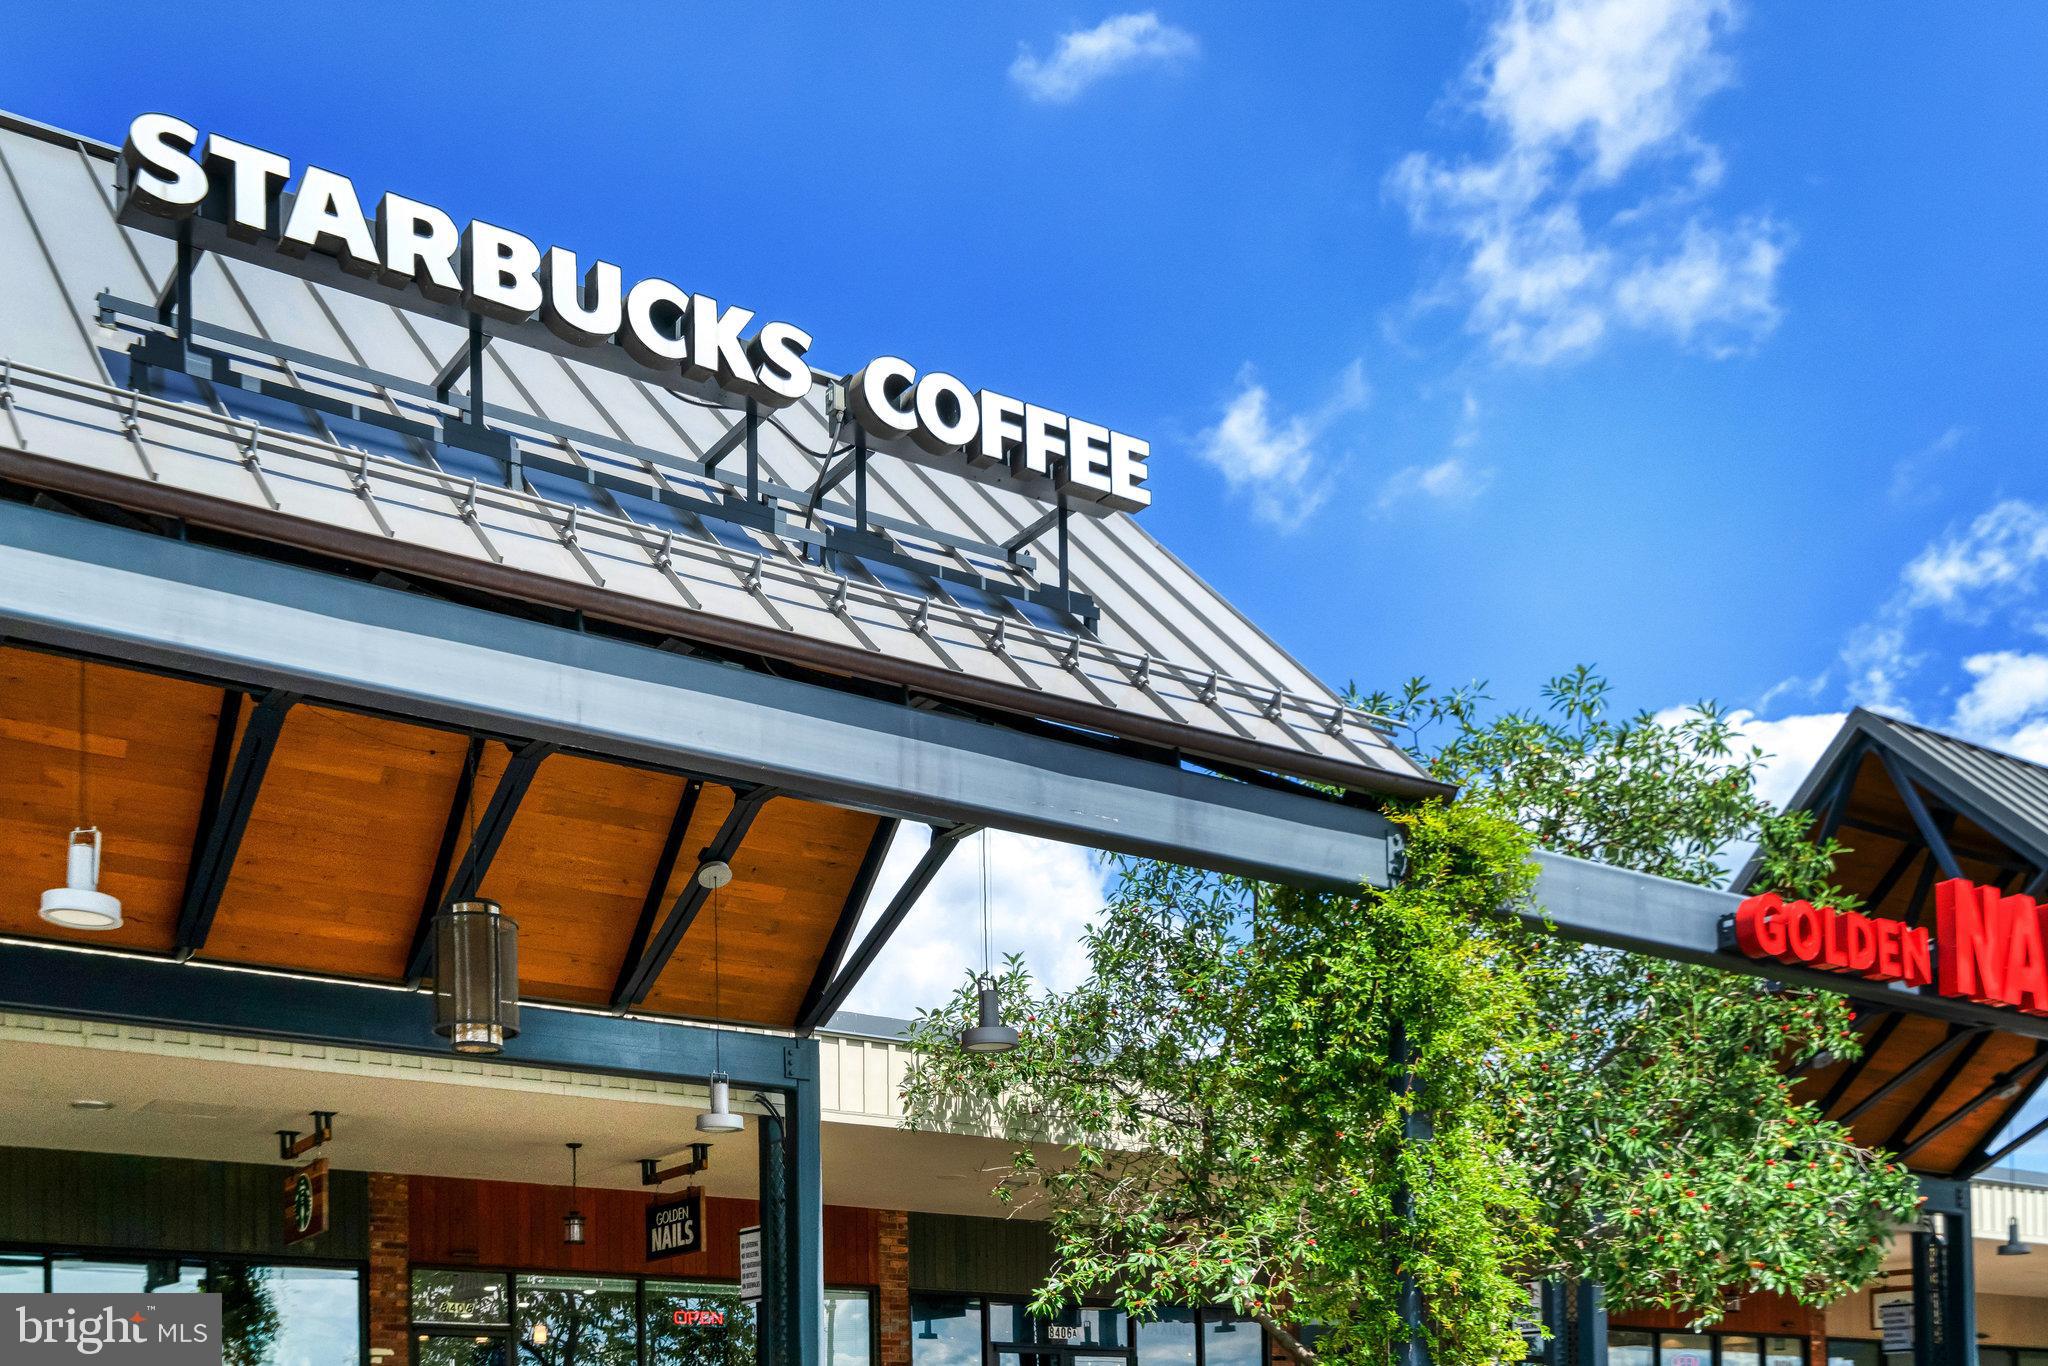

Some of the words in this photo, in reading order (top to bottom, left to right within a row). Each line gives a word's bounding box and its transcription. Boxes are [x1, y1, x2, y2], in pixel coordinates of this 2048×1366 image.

[128, 111, 813, 402] STARBUCKS
[860, 355, 1153, 512] COFFEE
[1737, 892, 1932, 987] GOLDEN
[1936, 877, 2048, 1019] NA
[656, 1205, 689, 1226] GOLDEN
[651, 1219, 695, 1252] NAILS
[440, 1302, 474, 1314] 8408
[673, 1309, 725, 1326] OPEN
